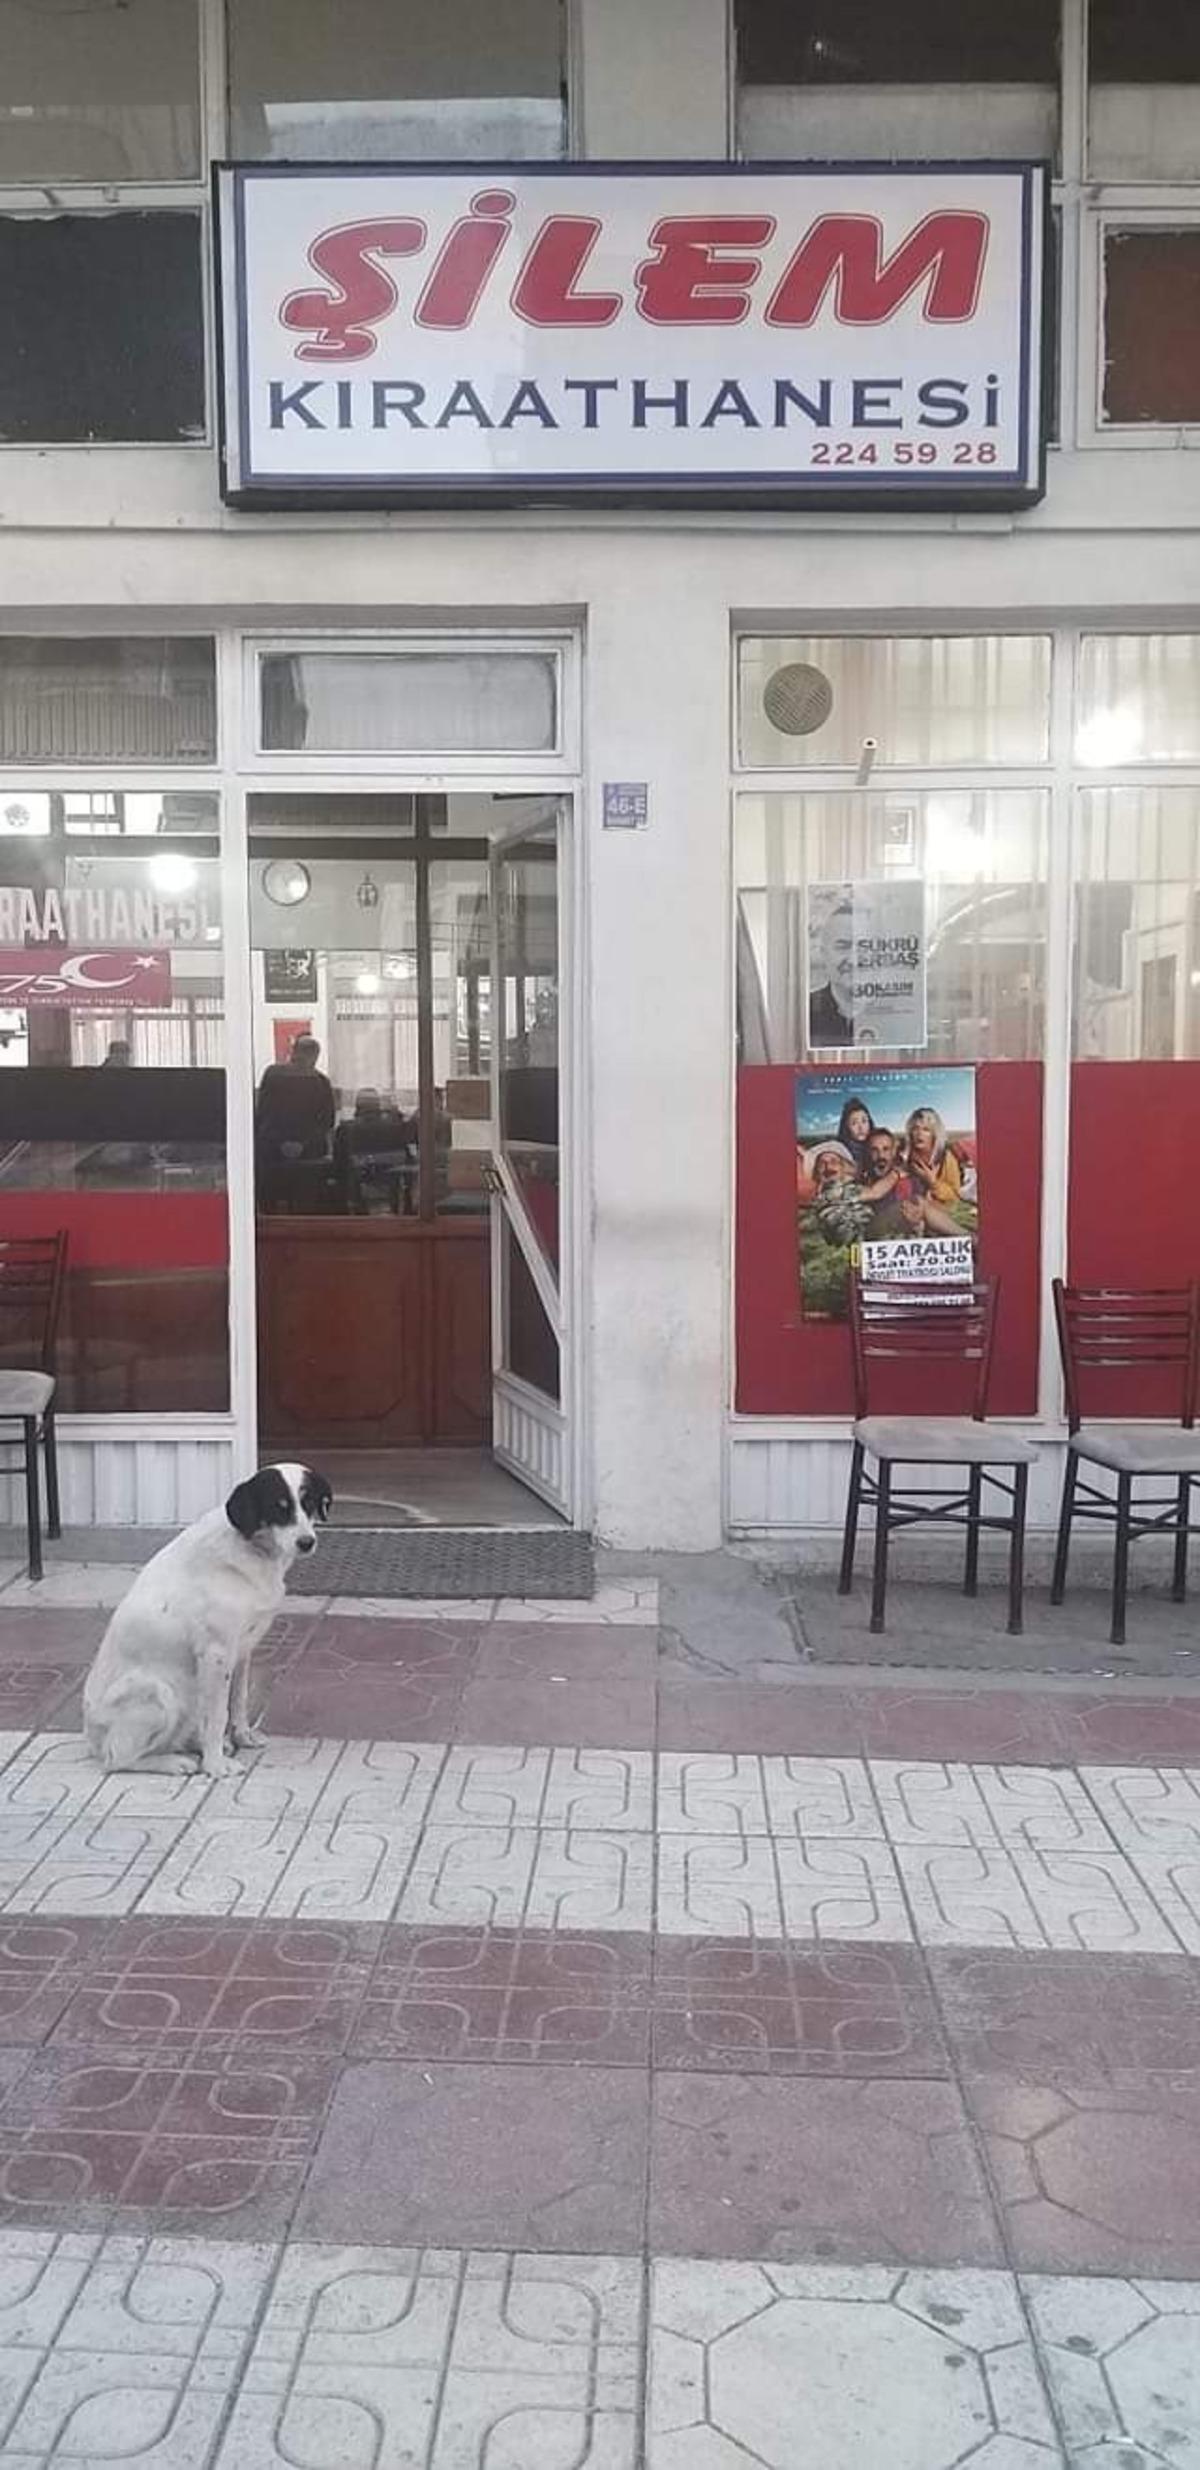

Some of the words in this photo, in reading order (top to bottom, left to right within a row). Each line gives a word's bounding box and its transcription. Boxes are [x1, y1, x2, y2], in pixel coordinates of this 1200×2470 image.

[278, 188, 991, 363] ŞİLEM
[811, 442, 878, 465] 224
[893, 442, 938, 465] 59
[953, 442, 997, 465] 28
[608, 796, 646, 815] 46-E
[866, 1246, 888, 1259] 15
[893, 1240, 971, 1258] ARALIK
